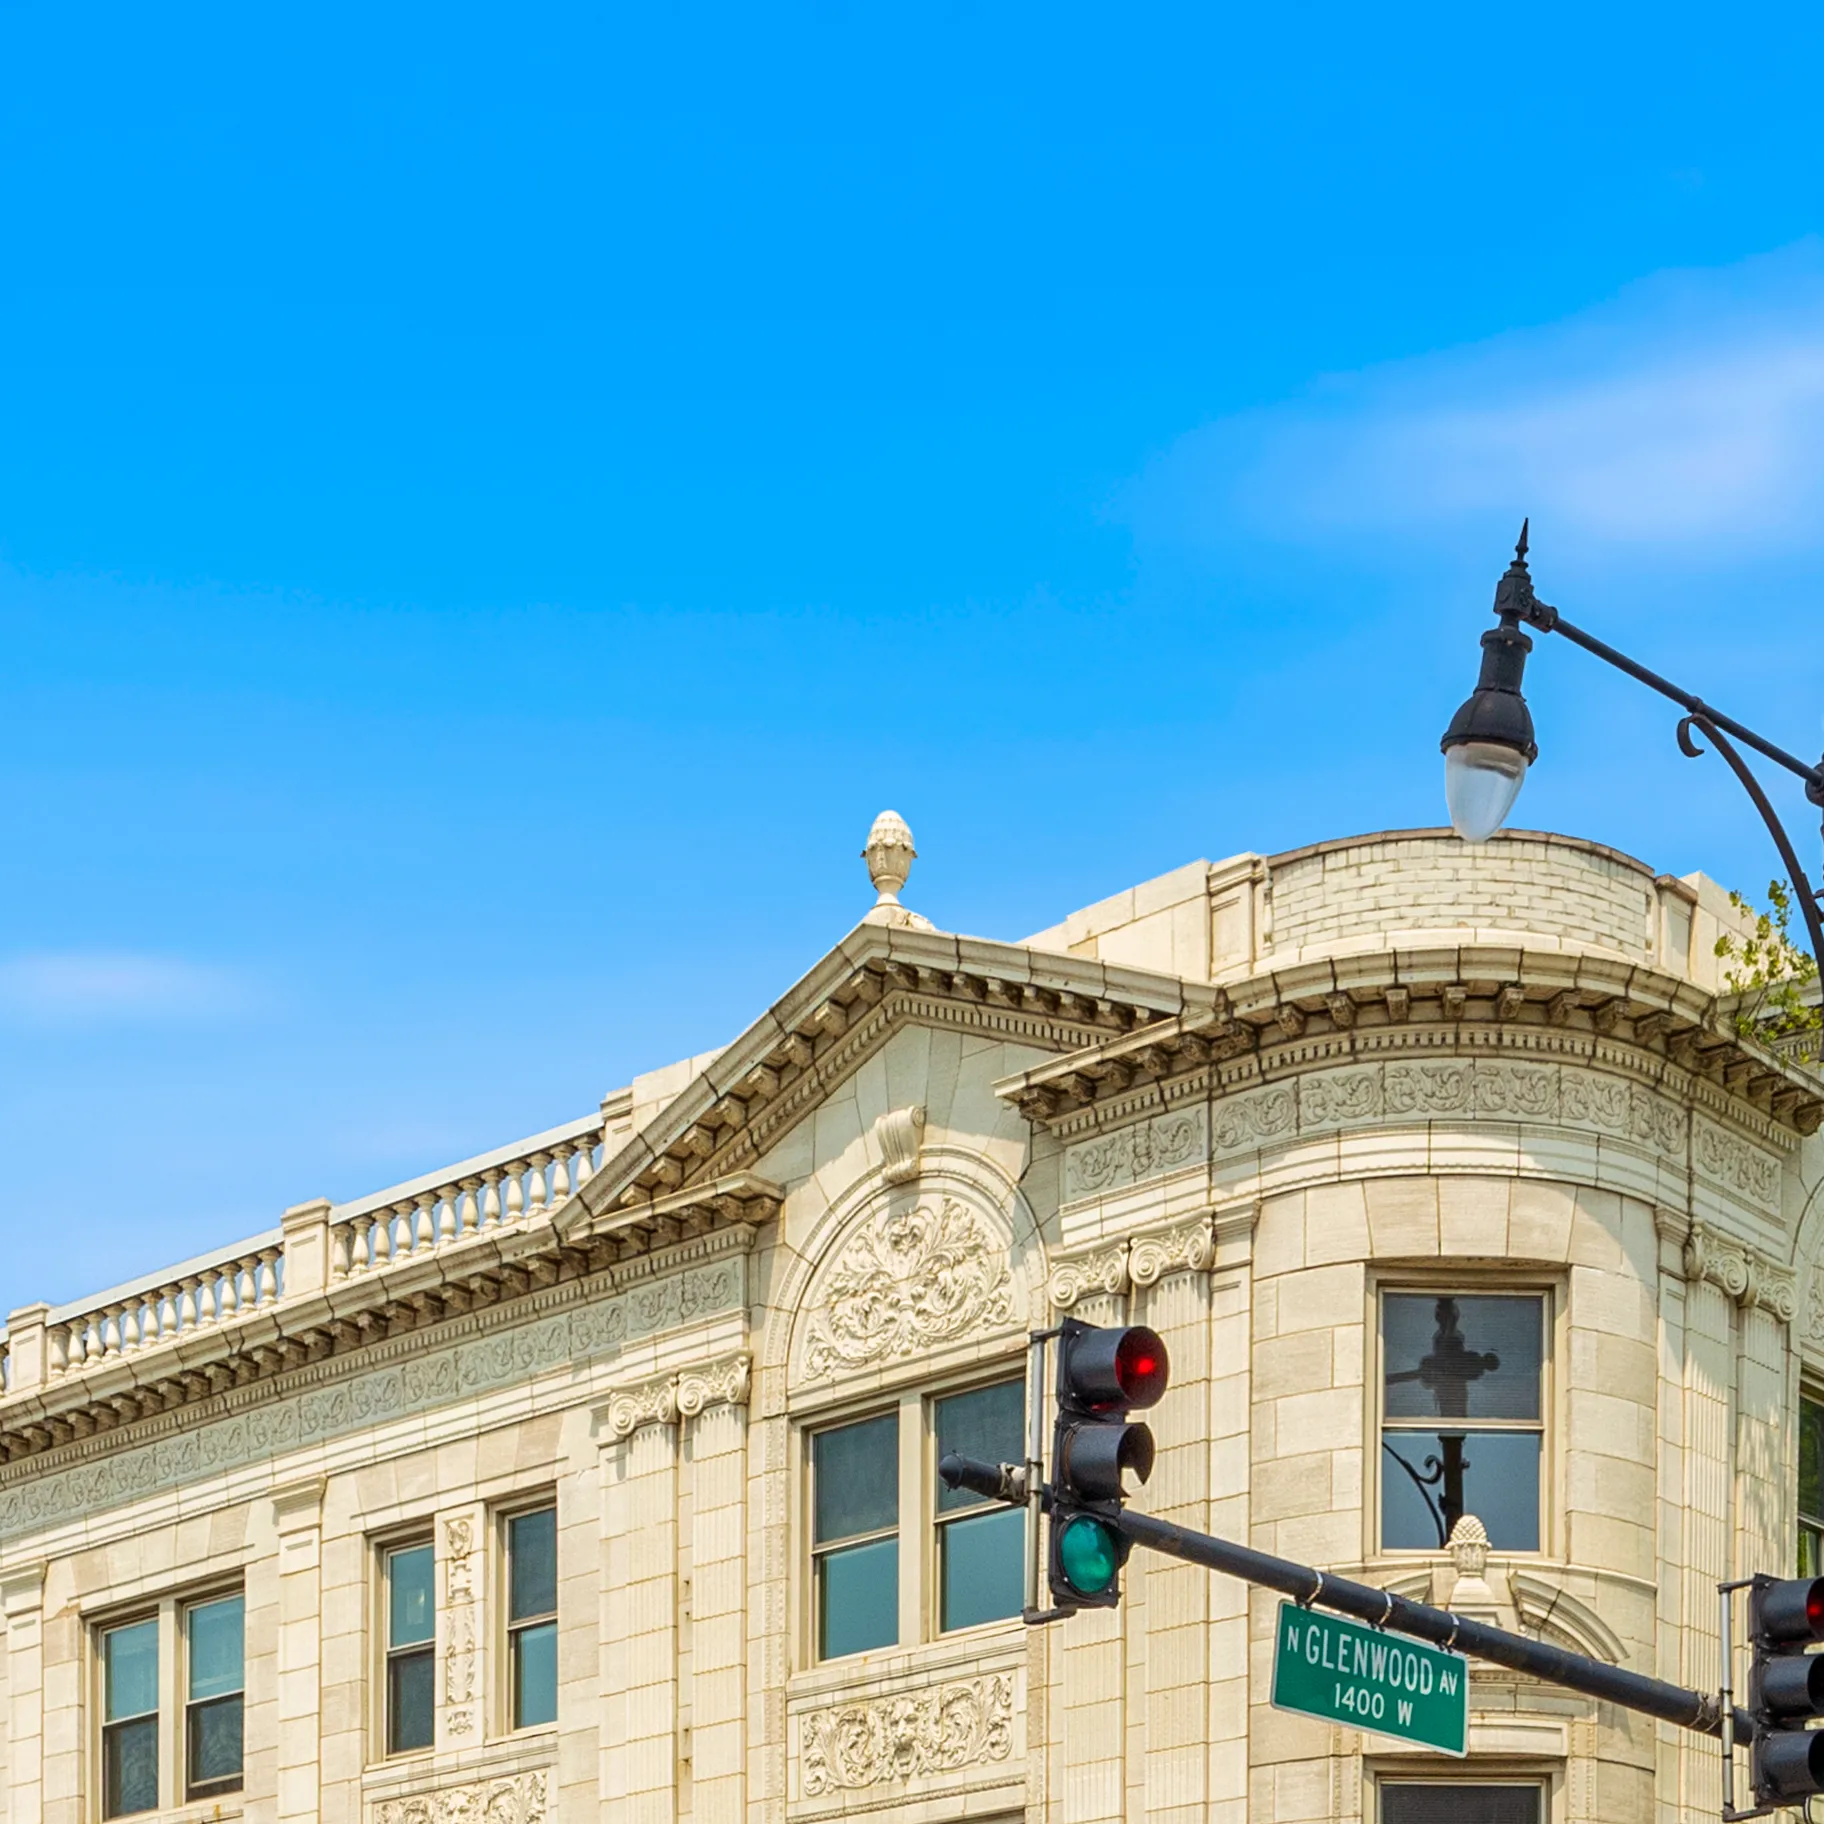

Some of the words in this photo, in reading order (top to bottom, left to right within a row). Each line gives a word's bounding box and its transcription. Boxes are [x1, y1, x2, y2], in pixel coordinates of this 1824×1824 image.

[1287, 1625, 1300, 1653] N
[1305, 1624, 1434, 1695] GLENWOOD
[1439, 1669, 1458, 1697] AV
[1335, 1682, 1385, 1719] 1400
[1398, 1698, 1414, 1727] W
